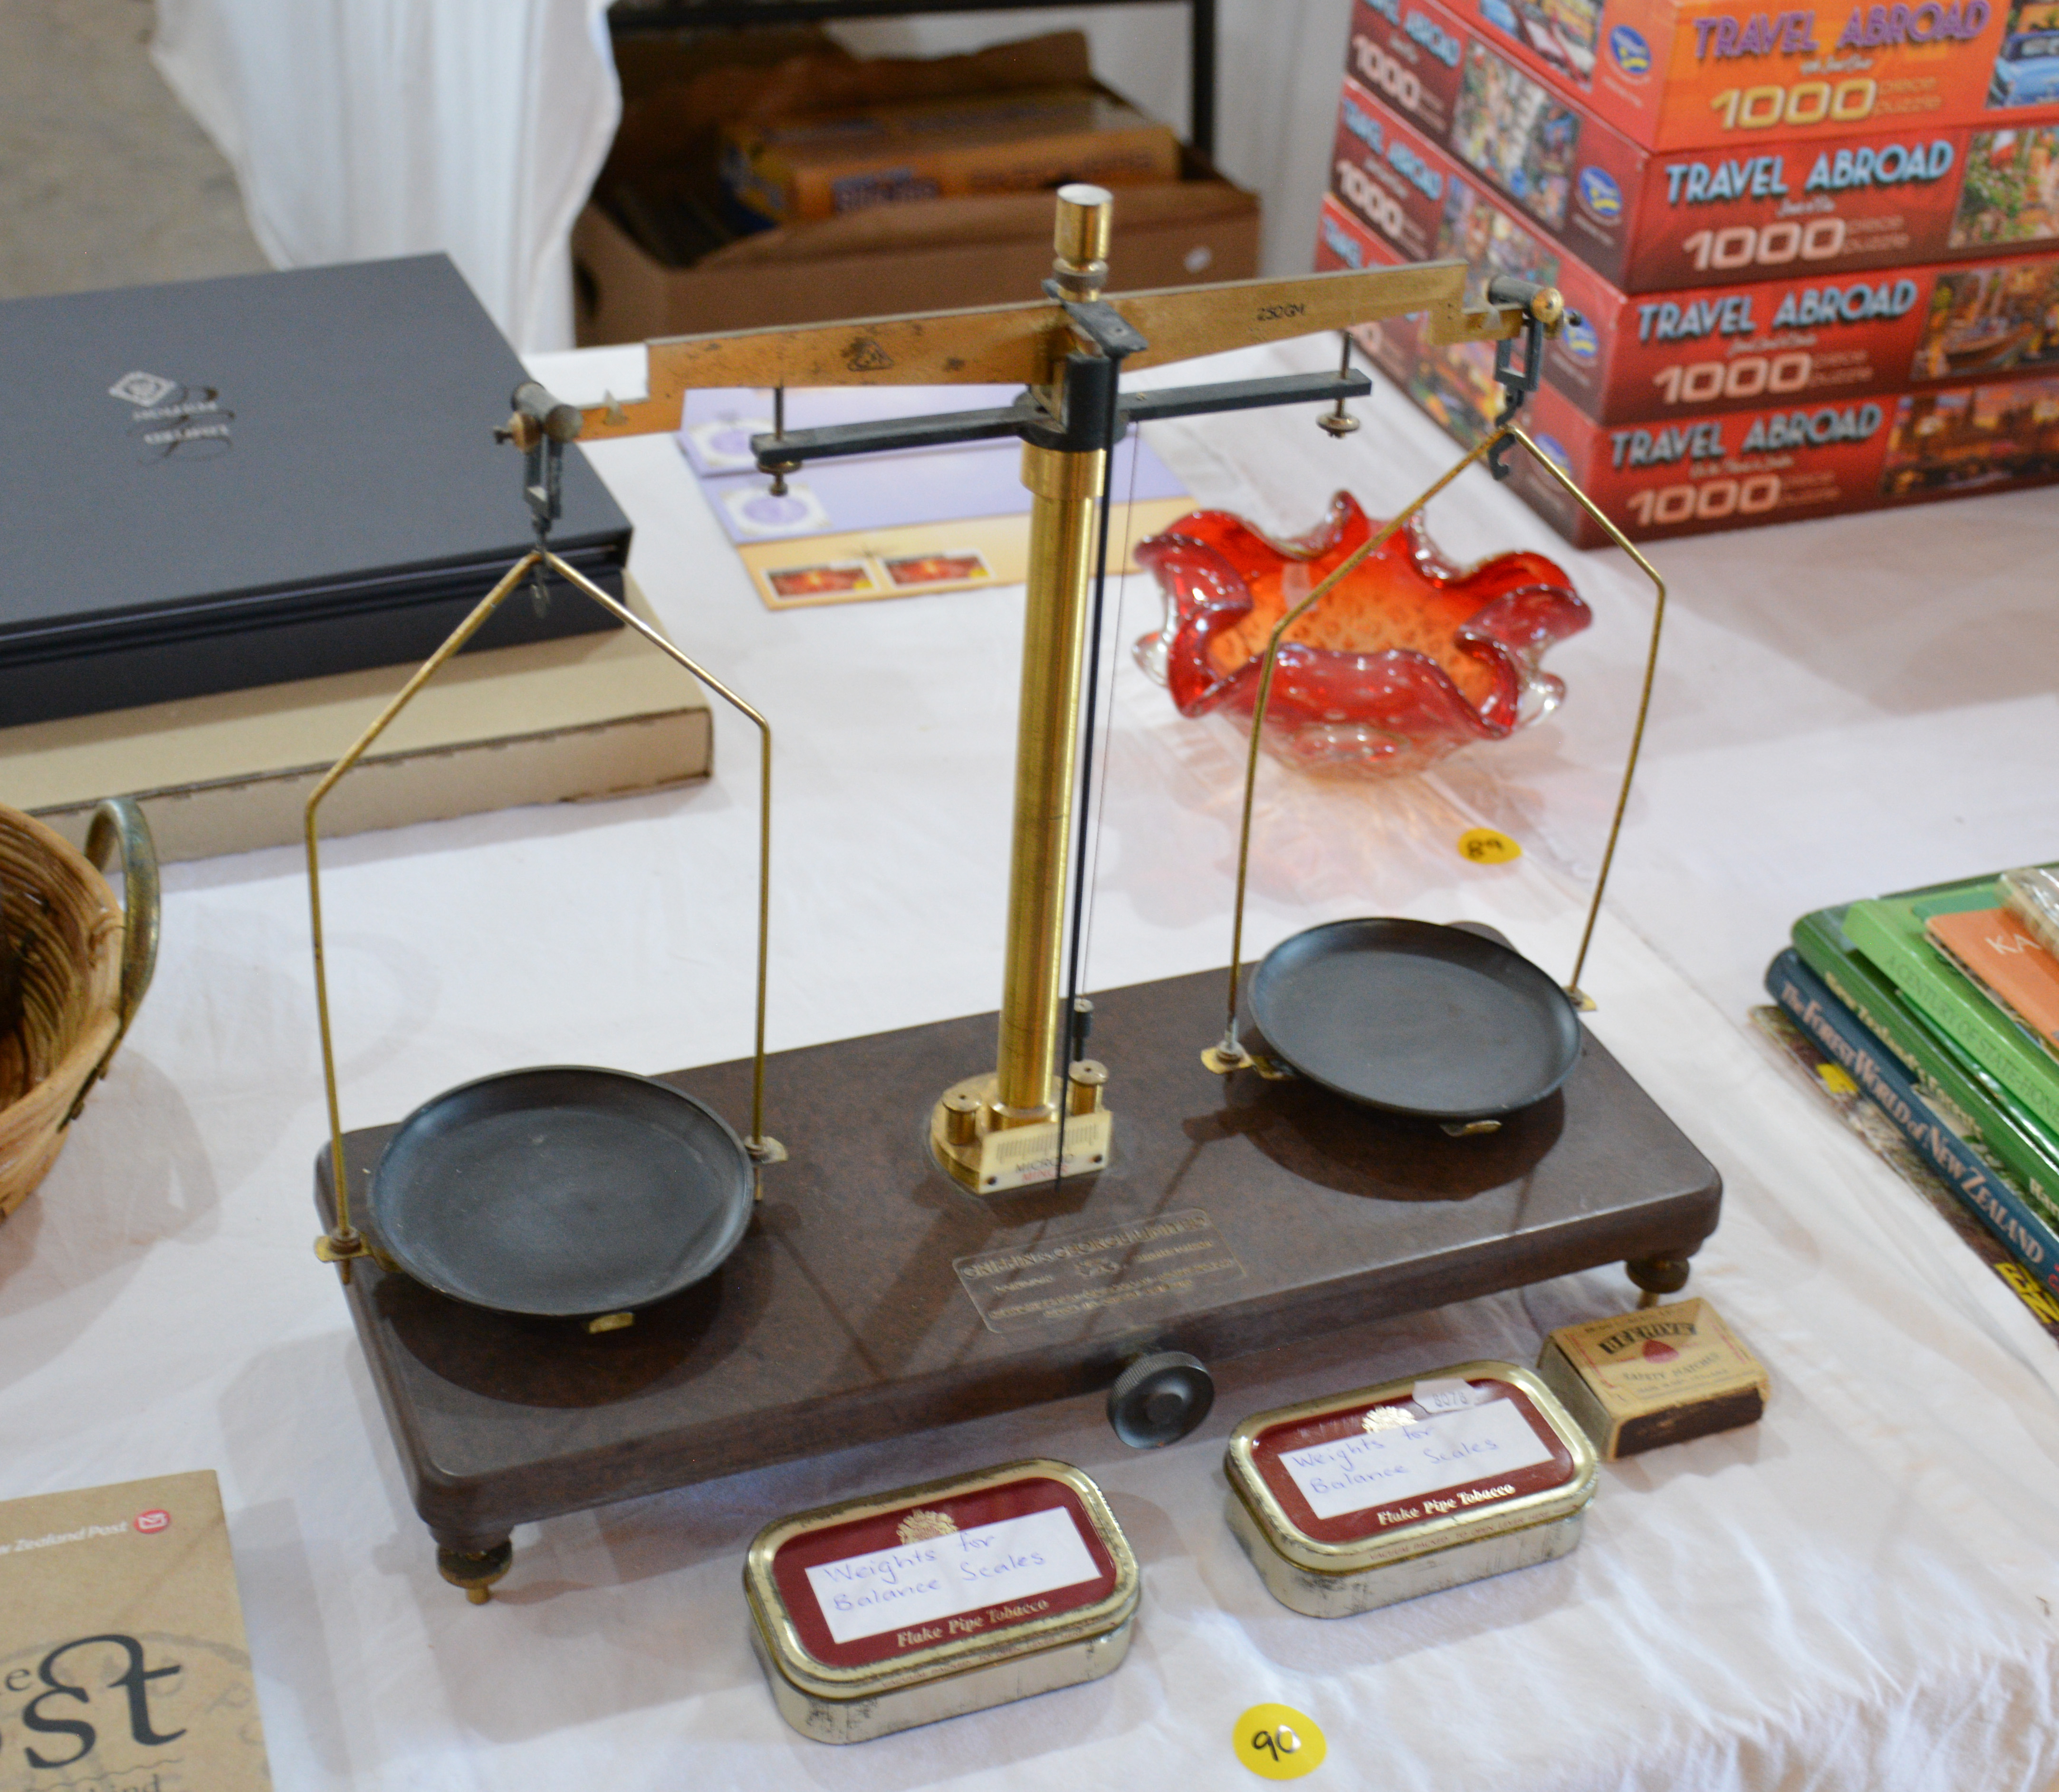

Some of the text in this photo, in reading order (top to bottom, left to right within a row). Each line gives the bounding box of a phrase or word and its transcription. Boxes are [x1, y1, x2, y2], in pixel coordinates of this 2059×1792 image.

[1693, 10, 1820, 58] TRAVEL
[1836, 0, 1991, 48] ABROAD
[1352, 33, 1421, 112] 1000
[1712, 79, 1876, 129] 1000
[1666, 155, 1789, 203] TRAVEL
[1804, 140, 1954, 191] ABROAD
[1335, 160, 1403, 239] 1000
[1683, 218, 1847, 271] 1000
[1637, 279, 1917, 343] TRAVEL ABROAD
[1653, 352, 1812, 404] 1000
[1610, 422, 1726, 468] TRAVEL
[1741, 402, 1883, 452] ABROAD
[1627, 474, 1782, 527] 1000
[1855, 1048, 1911, 1124] WORLD
[1961, 1167, 2043, 1264] ZEALAND
[1292, 1426, 1434, 1471] Weights for
[1310, 1439, 1499, 1494] Balance Scales
[1377, 1484, 1516, 1526] Flake Pipe Tobacco
[14, 1526, 86, 1552] Zealand
[88, 1521, 128, 1539] Post
[824, 1532, 995, 1584] Weights for
[833, 1551, 1046, 1611] Balance Scales
[896, 1598, 1050, 1648] Flake Pipe Tobacco
[1251, 1724, 1302, 1762] 90
